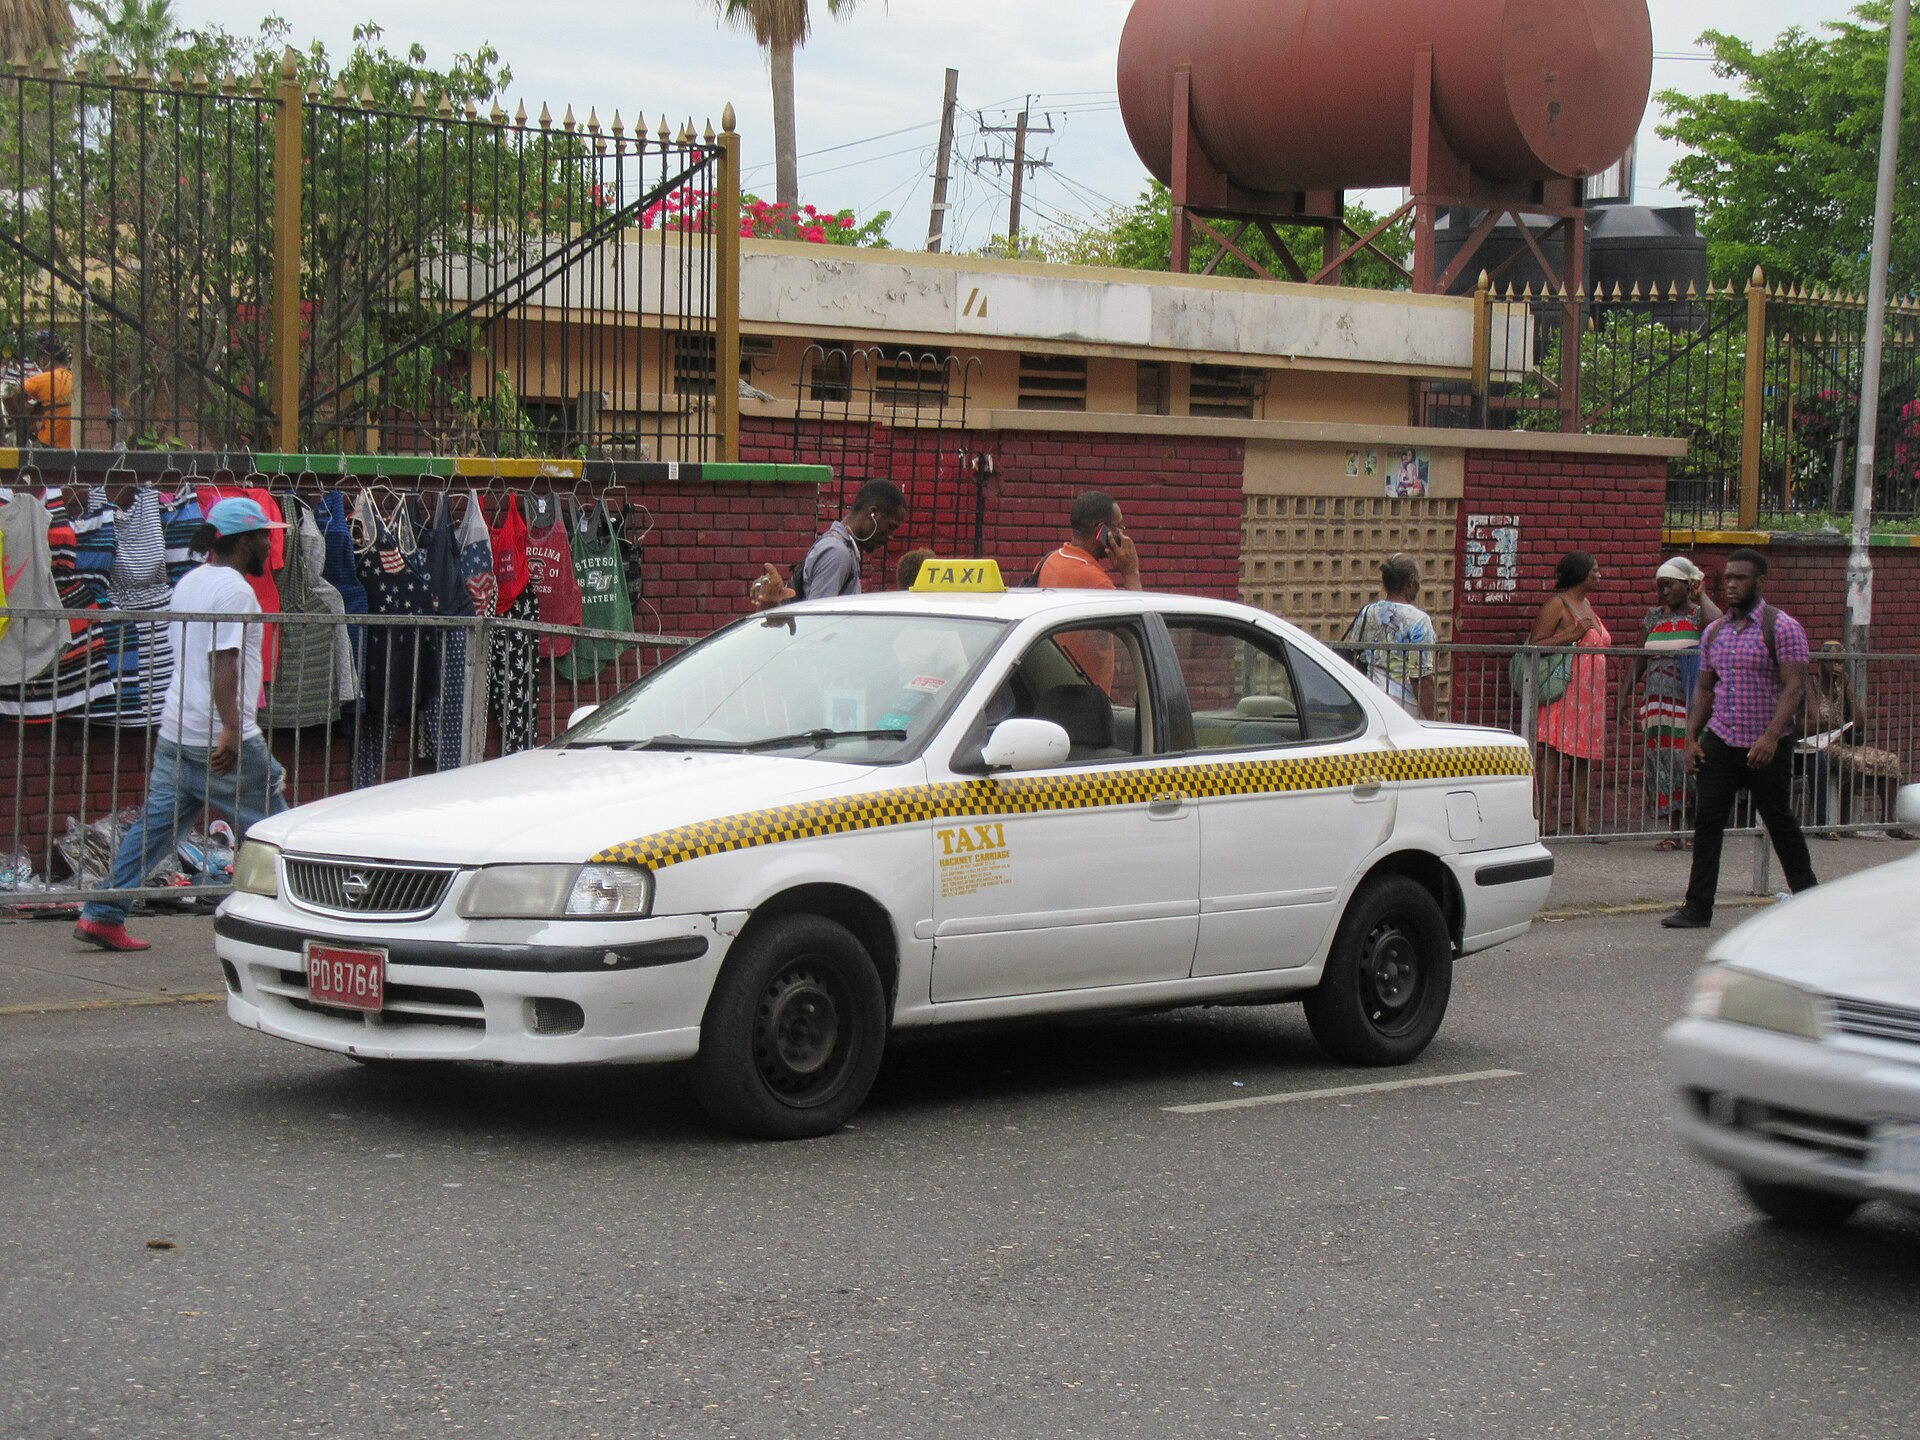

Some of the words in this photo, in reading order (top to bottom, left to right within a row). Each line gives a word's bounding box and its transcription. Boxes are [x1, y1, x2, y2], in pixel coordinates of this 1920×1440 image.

[526, 546, 561, 562] ROLINA
[927, 567, 984, 584] TAXI
[937, 823, 1006, 855] TAXI
